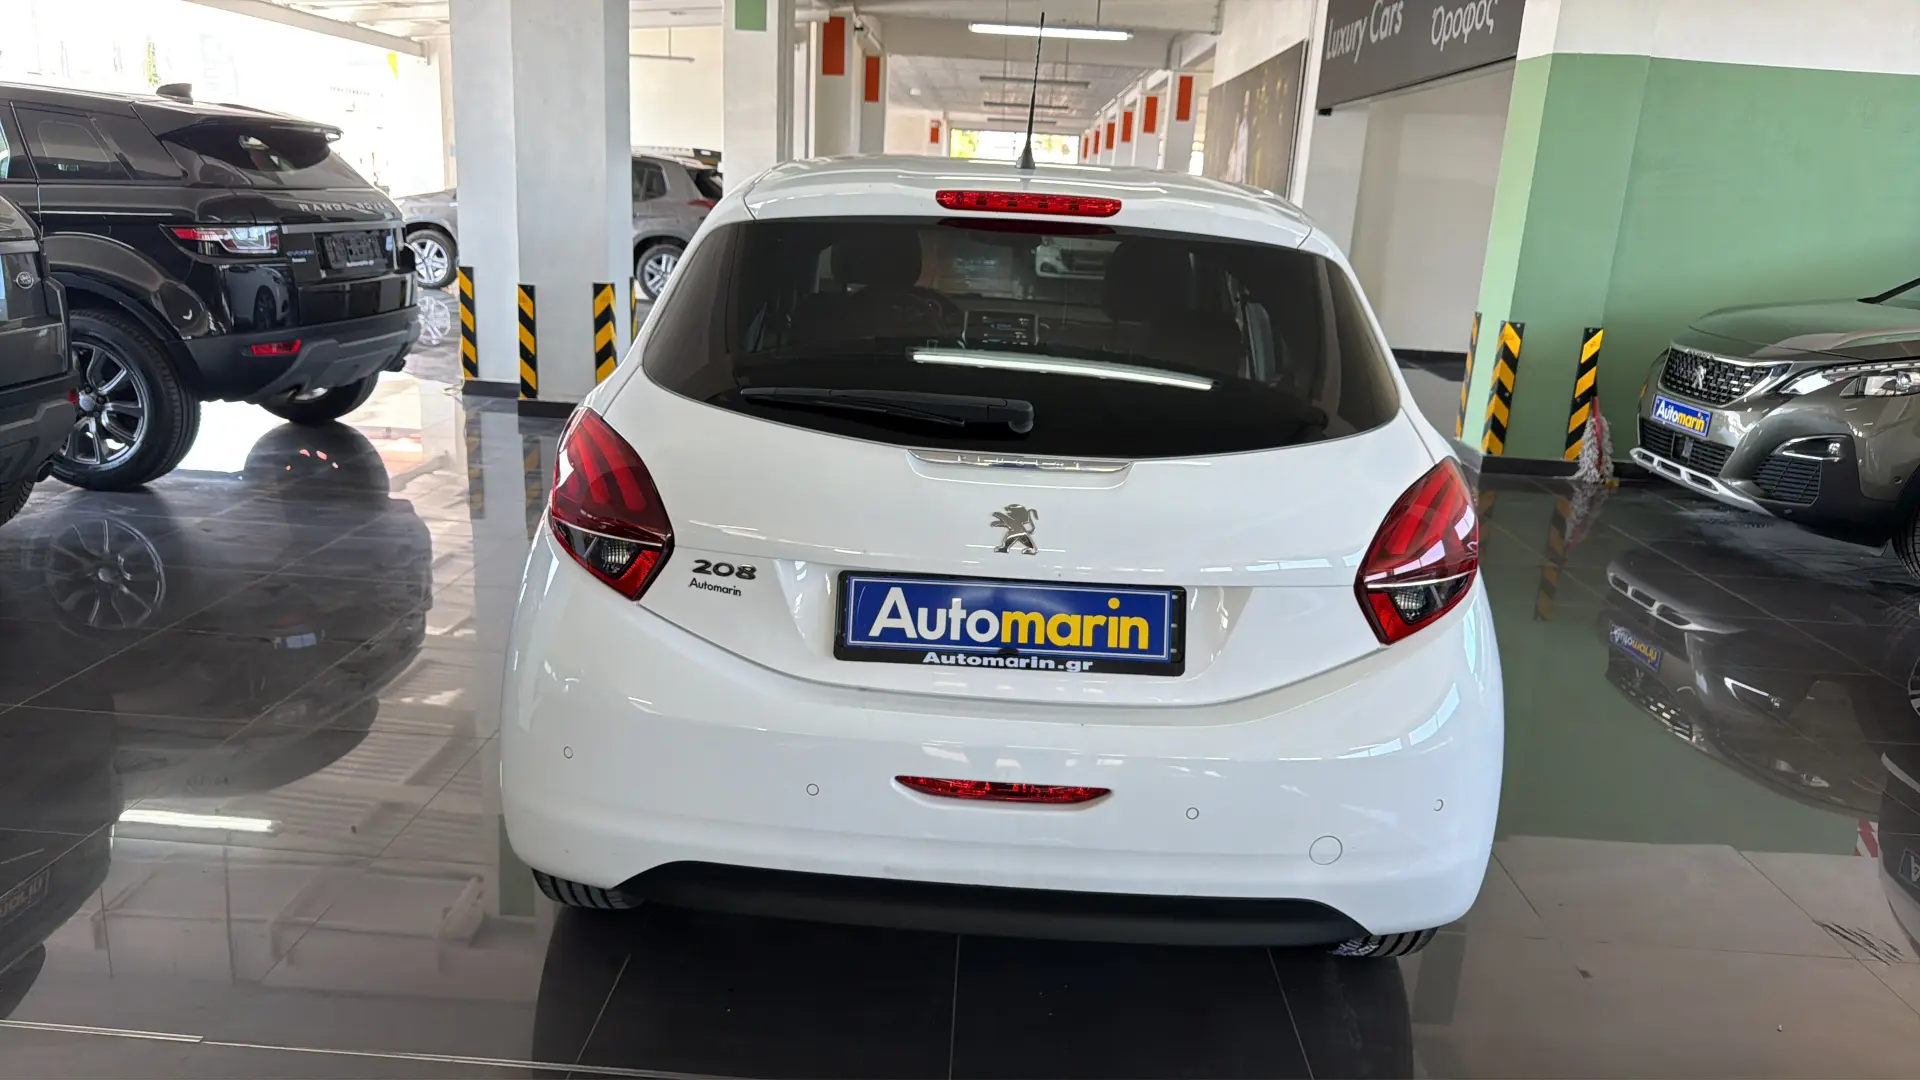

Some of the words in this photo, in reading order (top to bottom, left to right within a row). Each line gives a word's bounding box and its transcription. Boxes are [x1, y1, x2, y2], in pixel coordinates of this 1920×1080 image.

[1326, 16, 1367, 64] Luxury
[1370, 0, 1404, 43] Cars
[1431, 0, 1498, 52] Όροφος
[1656, 401, 1705, 431] Automarin
[692, 559, 757, 580] 208
[688, 577, 742, 597] Automarin
[868, 586, 1149, 650] Automarin
[922, 651, 1093, 673] Automarin.gr
